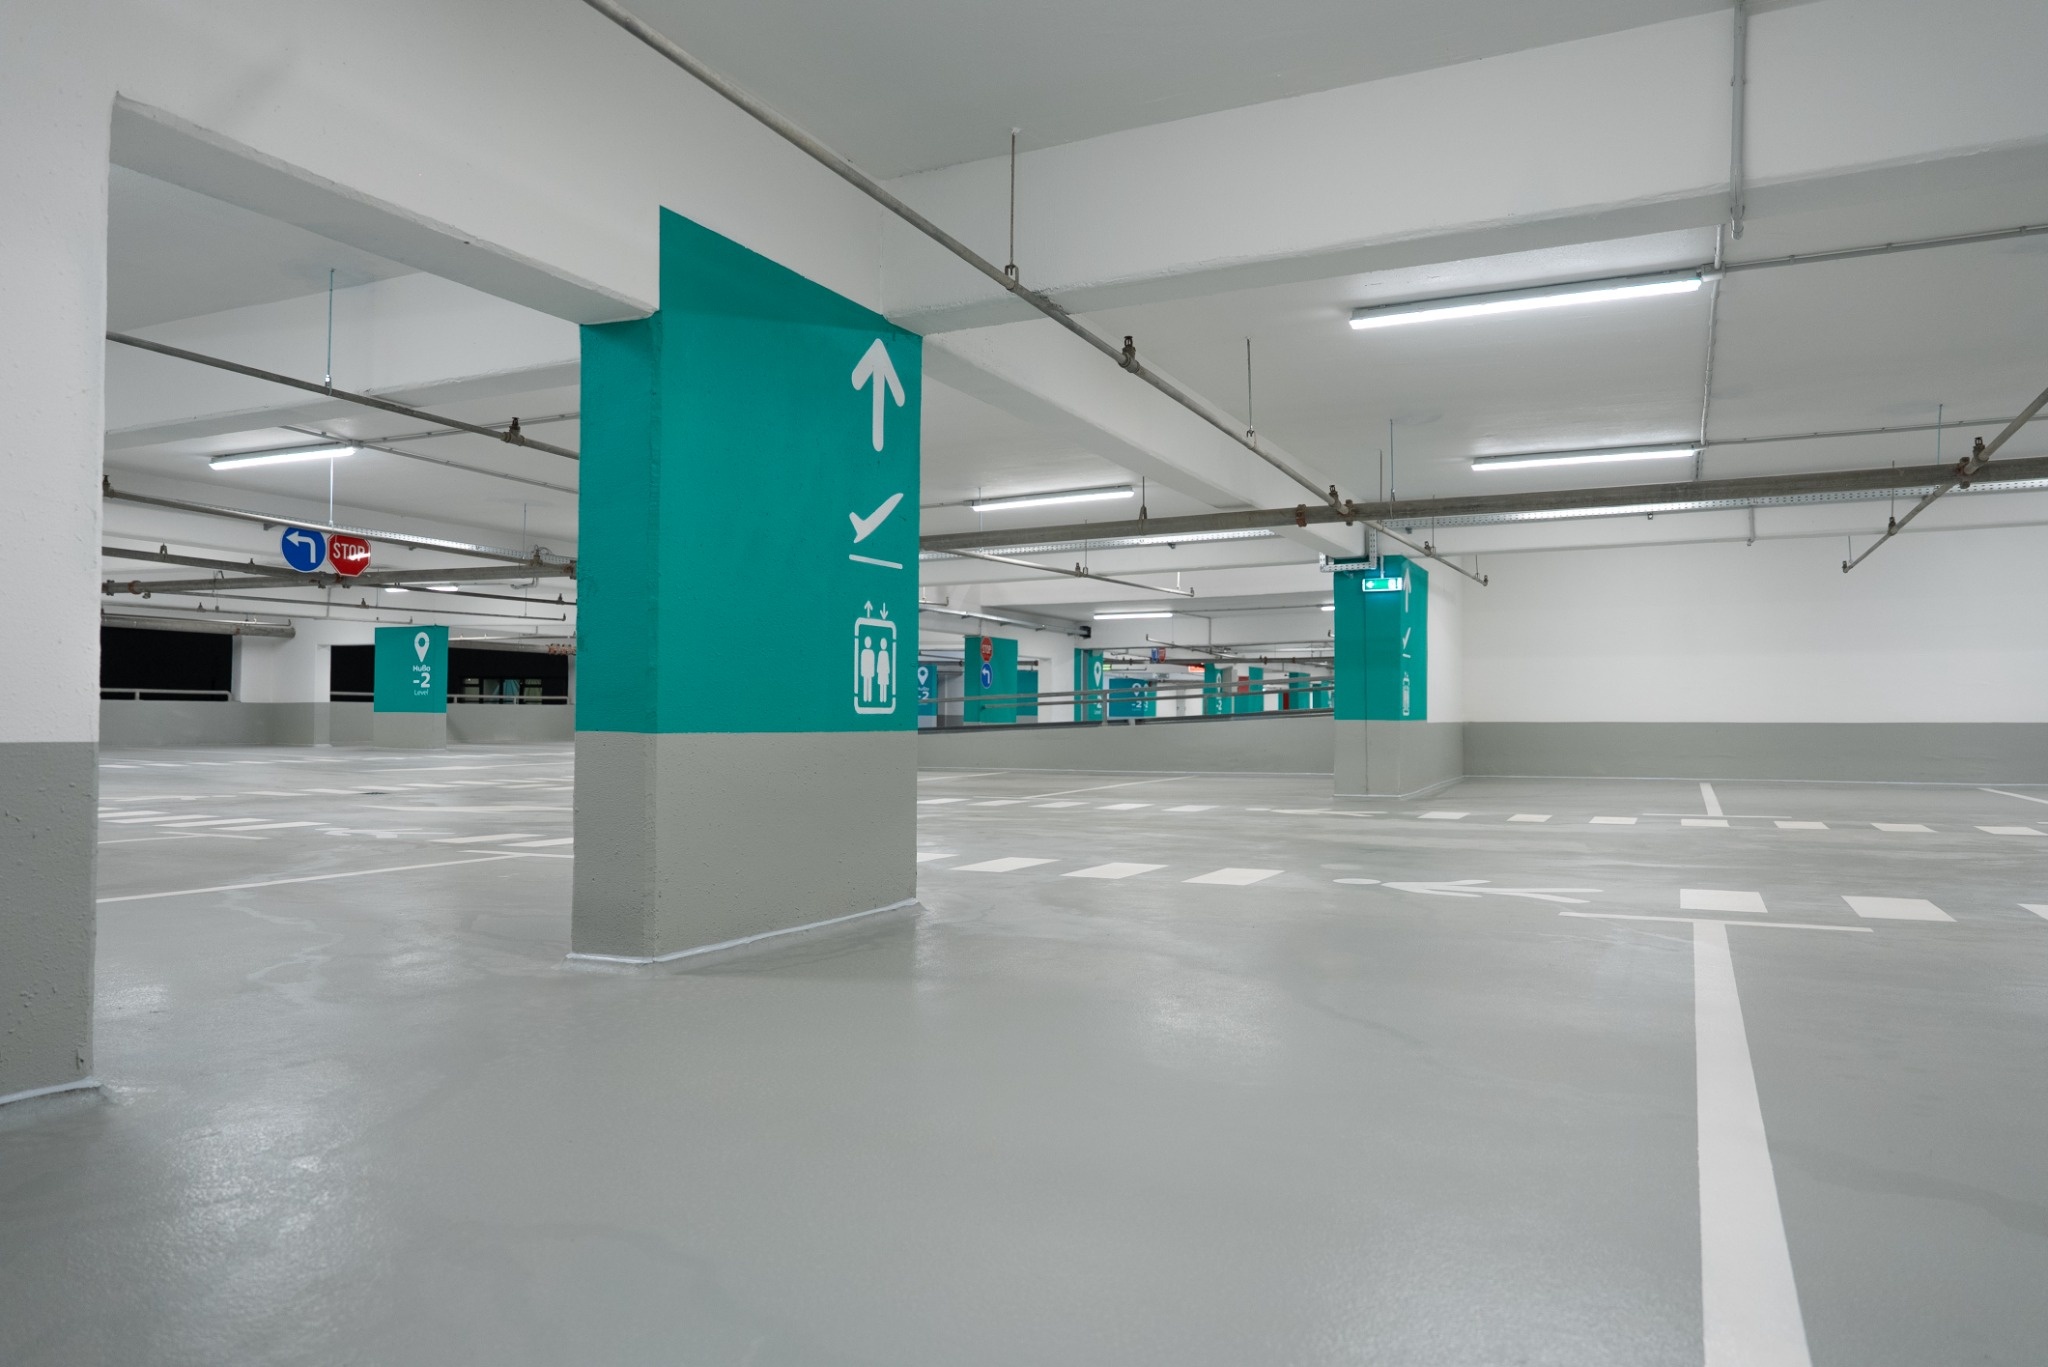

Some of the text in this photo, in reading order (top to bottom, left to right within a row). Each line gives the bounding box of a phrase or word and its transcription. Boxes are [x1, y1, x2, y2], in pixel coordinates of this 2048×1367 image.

[333, 542, 365, 562] STOP
[412, 672, 431, 688] -2
[414, 688, 429, 696] Level
[1131, 700, 1142, 708] -2
